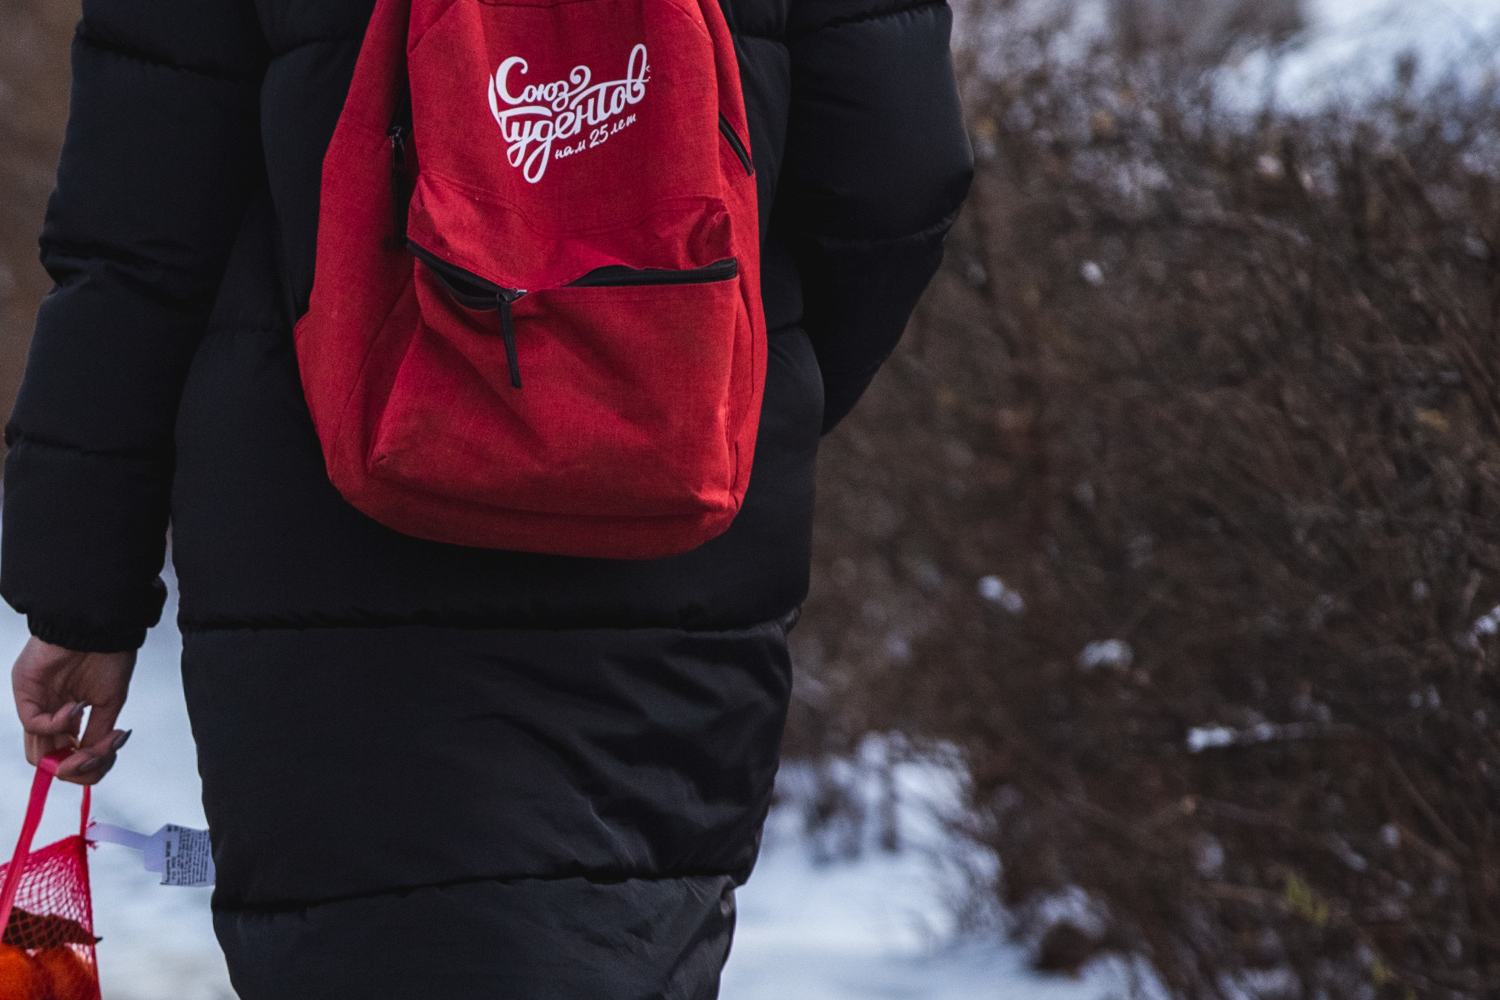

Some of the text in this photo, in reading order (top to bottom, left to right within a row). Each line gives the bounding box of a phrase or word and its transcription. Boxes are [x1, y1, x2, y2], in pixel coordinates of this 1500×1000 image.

[496, 56, 591, 112] Союз
[555, 113, 636, 160] нам 25 лет
